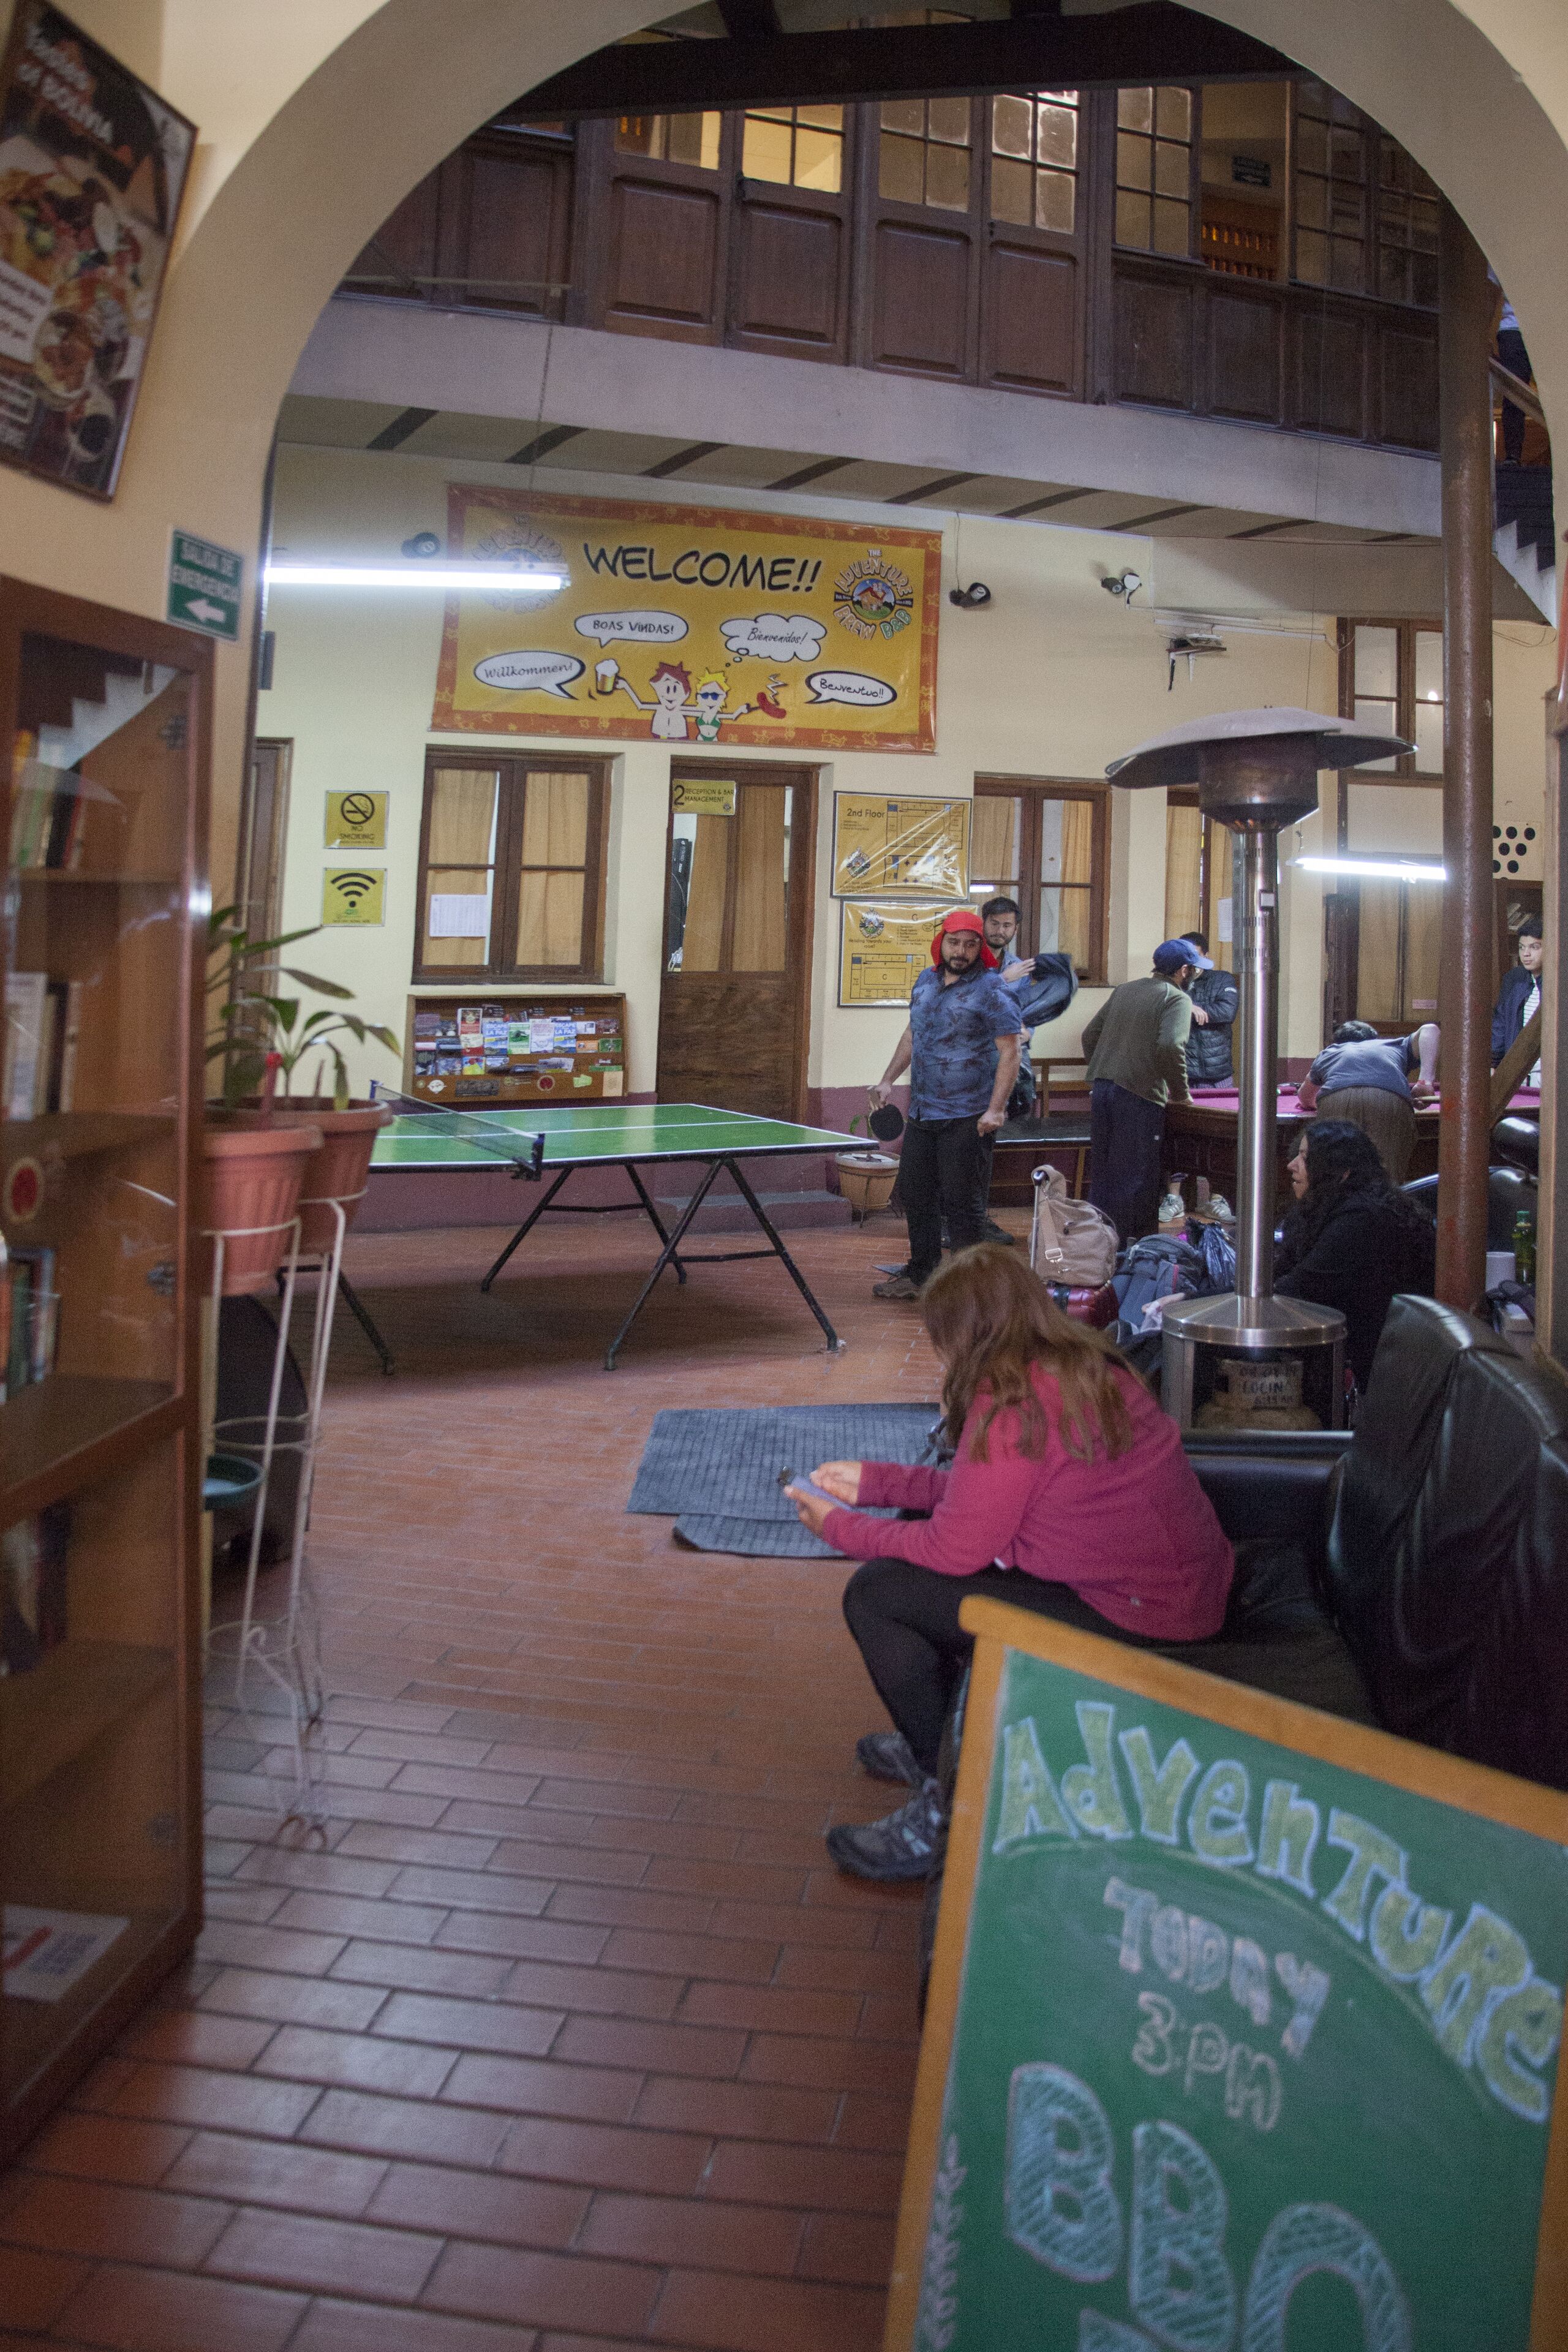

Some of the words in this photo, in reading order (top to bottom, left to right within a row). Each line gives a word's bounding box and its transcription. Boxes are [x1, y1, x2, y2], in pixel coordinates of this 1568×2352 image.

[583, 543, 822, 592] WELCOME!!
[834, 557, 913, 597] ADVENTURE
[593, 620, 624, 631] BOAS
[833, 605, 876, 640] BREW
[880, 609, 911, 640] B&B
[747, 627, 808, 645] Bienvenidos!
[484, 663, 573, 679] Willkommen!
[674, 785, 685, 805] 2
[846, 809, 862, 817] 2nd
[865, 809, 885, 818] Floor
